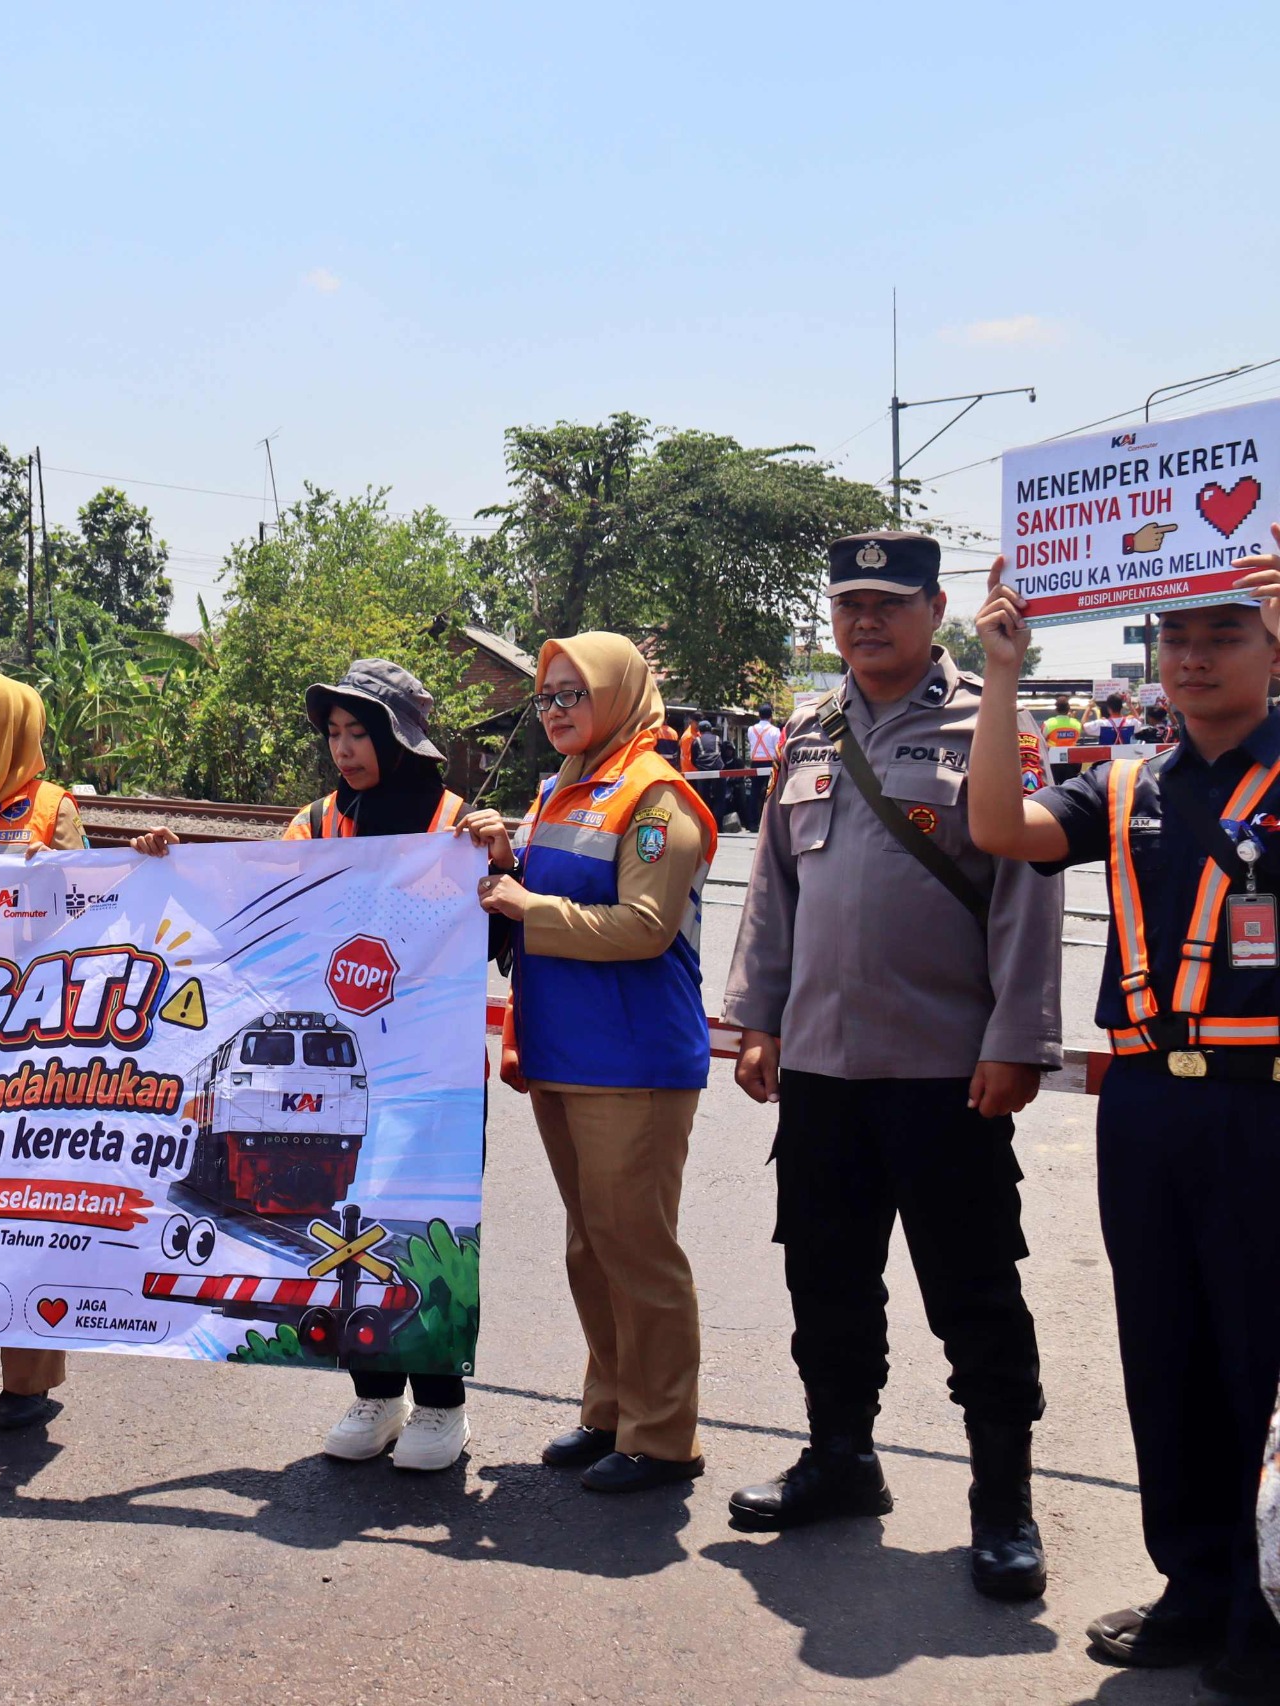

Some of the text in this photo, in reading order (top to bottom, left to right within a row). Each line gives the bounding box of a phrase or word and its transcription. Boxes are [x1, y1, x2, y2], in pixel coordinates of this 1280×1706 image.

[1128, 442, 1158, 452] Commuter
[1017, 438, 1259, 505] MENEMPER KERETA
[1016, 487, 1172, 537] SAKITNYA TUH
[1015, 534, 1092, 570] DISINI !
[1015, 571, 1083, 595] TUNGGU
[1088, 565, 1111, 586] KA
[1117, 557, 1164, 582] YANG
[1077, 581, 1189, 607] #DISIPLINPELNTASANKA
[895, 745, 966, 767] POLRI
[88, 894, 119, 903] CKAI
[3, 910, 48, 918] Commuter
[333, 959, 388, 993] STOP!
[11, 1116, 124, 1162] kereta
[131, 1124, 192, 1178] api
[0, 1229, 45, 1247] Tahun
[49, 1233, 92, 1251] 2007
[75, 1299, 106, 1312] JAGA
[75, 1316, 158, 1332] KESELAMATAN
